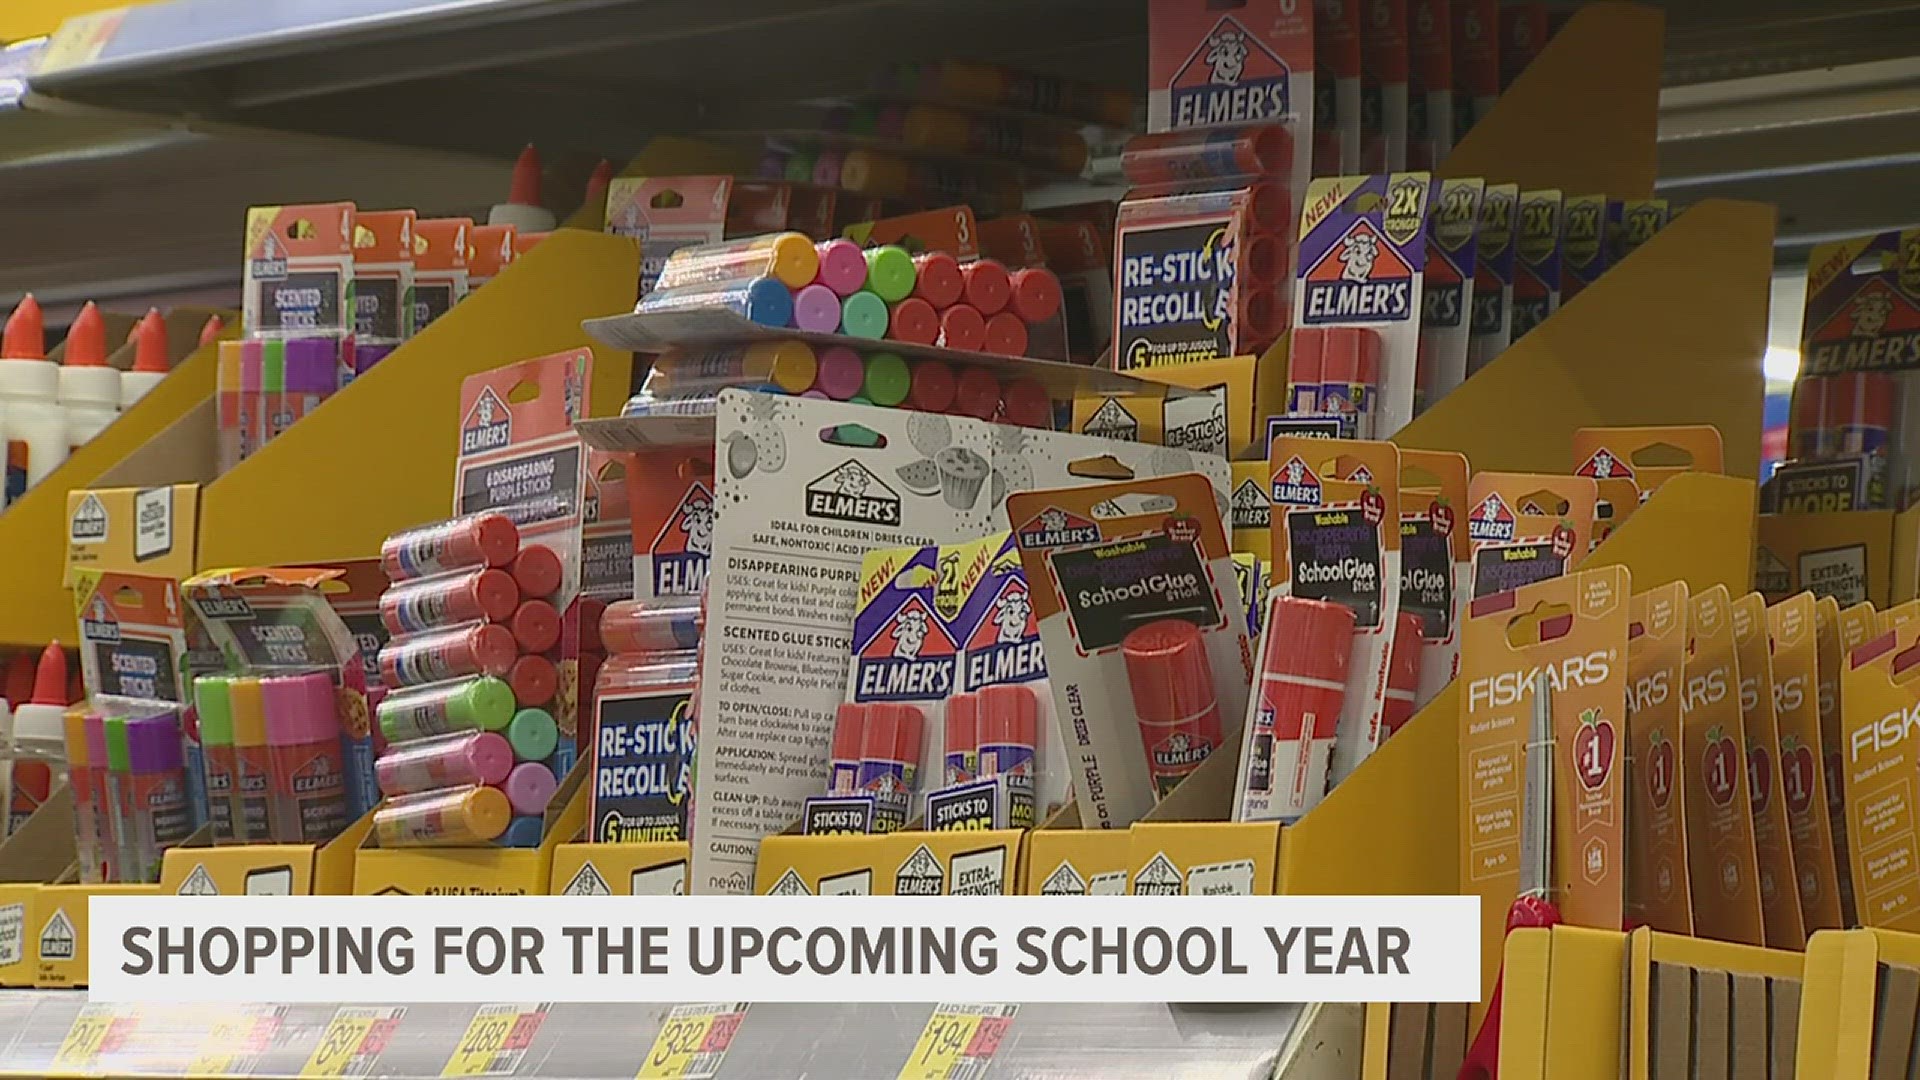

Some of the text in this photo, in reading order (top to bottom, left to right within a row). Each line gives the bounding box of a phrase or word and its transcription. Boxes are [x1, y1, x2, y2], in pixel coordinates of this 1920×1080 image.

[1176, 83, 1283, 127] ELMER'S
[711, 179, 726, 209] 4
[1305, 181, 1344, 227] NEW!
[1390, 187, 1420, 215] 2X
[1445, 192, 1473, 220] 2X
[340, 209, 351, 243] 4
[401, 216, 411, 249] 4
[956, 211, 969, 243] 3
[454, 225, 465, 257] 4
[501, 231, 512, 262] 4
[1124, 247, 1234, 288] RE-STICK
[1810, 246, 1851, 290] NEW!
[275, 289, 321, 308] SCENTED
[1308, 282, 1408, 318] ELMER'S
[1134, 346, 1147, 367] 5
[465, 425, 508, 451] ELMER'S
[1168, 414, 1224, 447] RE-STICK
[492, 458, 555, 486] DISAPPEARING
[1831, 475, 1848, 489] TO
[490, 475, 551, 503] PURPLE STICKS
[1274, 484, 1319, 503] ELMER'S
[810, 494, 898, 522] ELMER'S
[771, 520, 798, 533] IDEAL
[800, 524, 820, 535] FOR
[821, 527, 870, 541] CHILDREN
[874, 532, 902, 544] DRIES
[1024, 528, 1095, 547] ELMER'S
[1470, 522, 1512, 539] ELMER'S
[752, 533, 779, 547] SAFE,
[780, 537, 831, 551] NONTOXIC
[837, 543, 859, 554] ACID
[1092, 541, 1147, 560] Washable
[728, 557, 818, 578] DISAPPEARING
[960, 545, 991, 596] NEW!
[1299, 559, 1344, 584] School
[727, 575, 752, 587] USES:
[752, 577, 776, 589] Great
[777, 579, 789, 589] for
[811, 584, 838, 598] Purple
[860, 557, 896, 602] NEW!
[1078, 572, 1198, 608] School Glue
[165, 583, 176, 615] 4
[203, 600, 248, 615] ELMER'S
[764, 591, 779, 602] but
[818, 598, 834, 609] and
[725, 602, 771, 615] permanent
[796, 609, 828, 621] Washes
[252, 625, 304, 641] SCENTED
[723, 625, 780, 643] SCENTED
[782, 631, 813, 646] GLUE
[112, 652, 156, 674] SCENTED
[266, 645, 307, 661] STICKS
[748, 645, 772, 658] Great
[773, 648, 786, 659] for
[721, 655, 762, 669] Chocolate
[801, 662, 839, 678] Blueberry
[860, 661, 953, 695] ELMER'S
[719, 683, 729, 692] of
[720, 669, 744, 682] Sugar
[778, 675, 794, 685] and
[796, 677, 819, 689] Apple
[1469, 651, 1609, 713] FISKARS
[719, 701, 731, 711] TO
[732, 702, 792, 718] OPEN/CLOSE:
[811, 711, 822, 721] up
[1066, 683, 1084, 716] CLEAR
[717, 726, 738, 738] After
[739, 730, 754, 740] use
[755, 730, 786, 744] replace
[788, 734, 803, 745] cap
[738, 716, 758, 728] base
[760, 718, 800, 732] clockwise
[801, 721, 811, 732] to
[1073, 717, 1091, 746] DRIES
[601, 719, 694, 757] RE-STICK
[715, 746, 776, 760] APPLICATION:
[778, 753, 808, 766] Spread
[1156, 744, 1212, 765] ELMER'S
[768, 764, 808, 778] and press
[1081, 754, 1105, 802] PURPLE
[712, 805, 740, 817] excess
[741, 806, 754, 817] off
[762, 808, 783, 819] table
[762, 795, 779, 806] Rub
[936, 798, 988, 822] STICKS TO
[813, 811, 863, 828] STICKS TO
[607, 820, 618, 843] 5
[710, 842, 757, 856] CAUTION:
[898, 879, 942, 894] ELMER'S
[958, 865, 994, 886] EXTRA-
